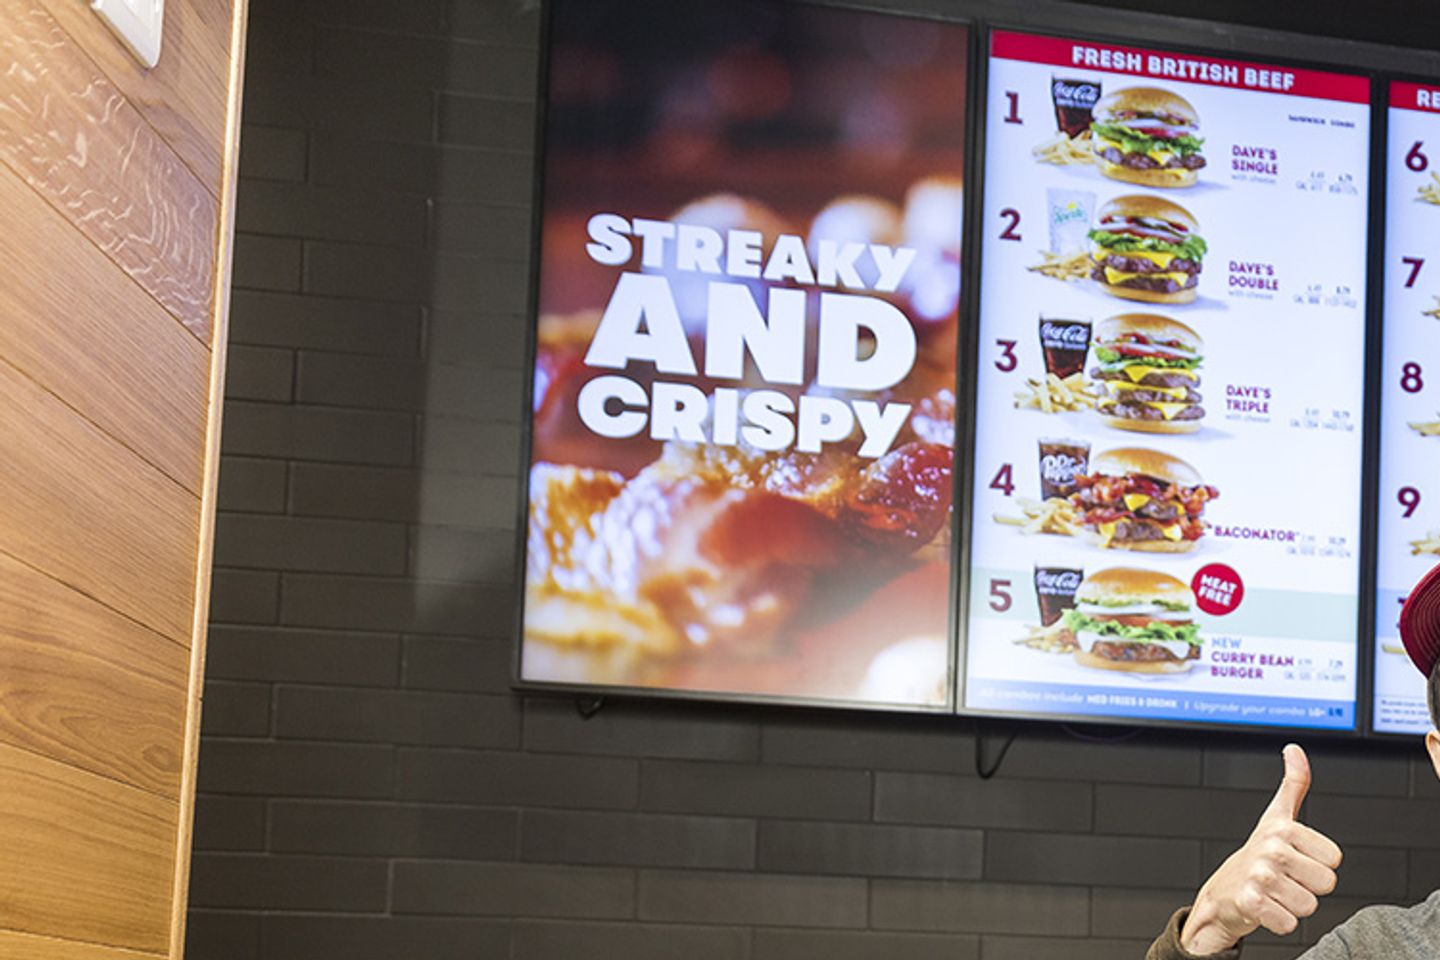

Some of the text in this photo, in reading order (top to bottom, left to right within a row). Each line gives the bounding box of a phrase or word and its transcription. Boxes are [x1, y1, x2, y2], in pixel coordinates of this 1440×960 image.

[1072, 46, 1294, 91] FRESH BRITISH BEEF
[1004, 92, 1023, 124] 1
[1232, 145, 1277, 160] DAVE'S
[1232, 159, 1278, 175] SINGLE
[1405, 141, 1428, 172] 6
[999, 209, 1022, 241] 2
[585, 213, 917, 292] STREAKY
[1229, 261, 1274, 276] DAVE'S
[1229, 275, 1278, 290] DOUBLE
[1402, 257, 1425, 288] 7
[584, 272, 917, 391] AND
[995, 340, 1018, 372] 3
[1226, 384, 1272, 399] DAVE'S
[1400, 362, 1424, 393] 8
[577, 375, 912, 458] CRISPY
[1226, 399, 1269, 414] TRIPLE
[989, 464, 1015, 496] 4
[1397, 486, 1421, 518] 9
[988, 580, 1013, 612] 5
[1198, 586, 1233, 607] FREE
[1201, 574, 1238, 594] MEAT
[1211, 651, 1294, 666] CURRY BEAN
[1212, 638, 1242, 649] NEW
[1211, 666, 1263, 679] BURGER
